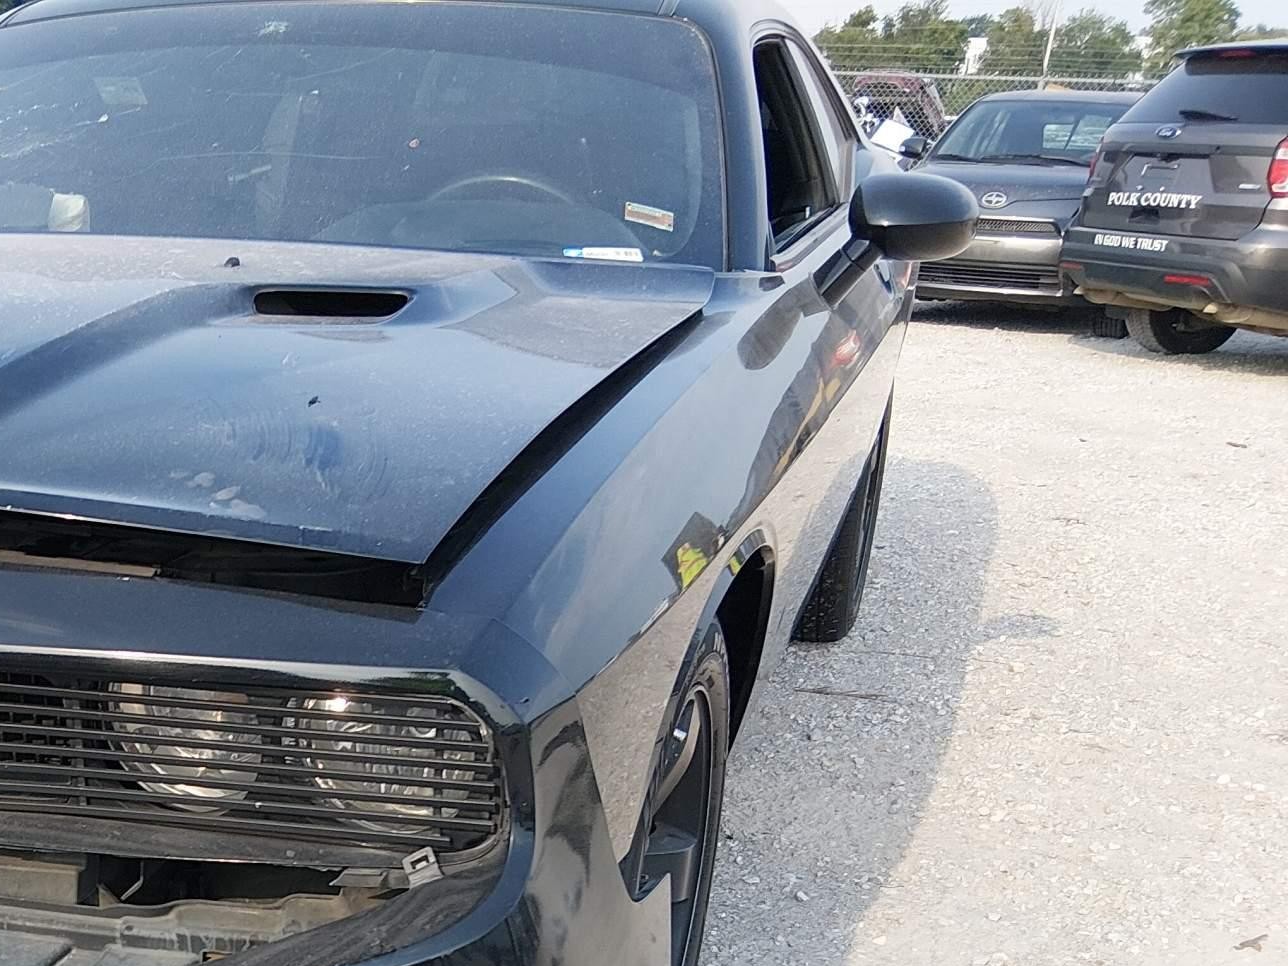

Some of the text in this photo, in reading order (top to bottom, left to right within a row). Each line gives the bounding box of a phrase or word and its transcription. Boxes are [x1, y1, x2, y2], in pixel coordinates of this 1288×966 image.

[1107, 192, 1203, 209] POLK COUNTY
[1094, 234, 1169, 252] IN GOD WE TRUST
